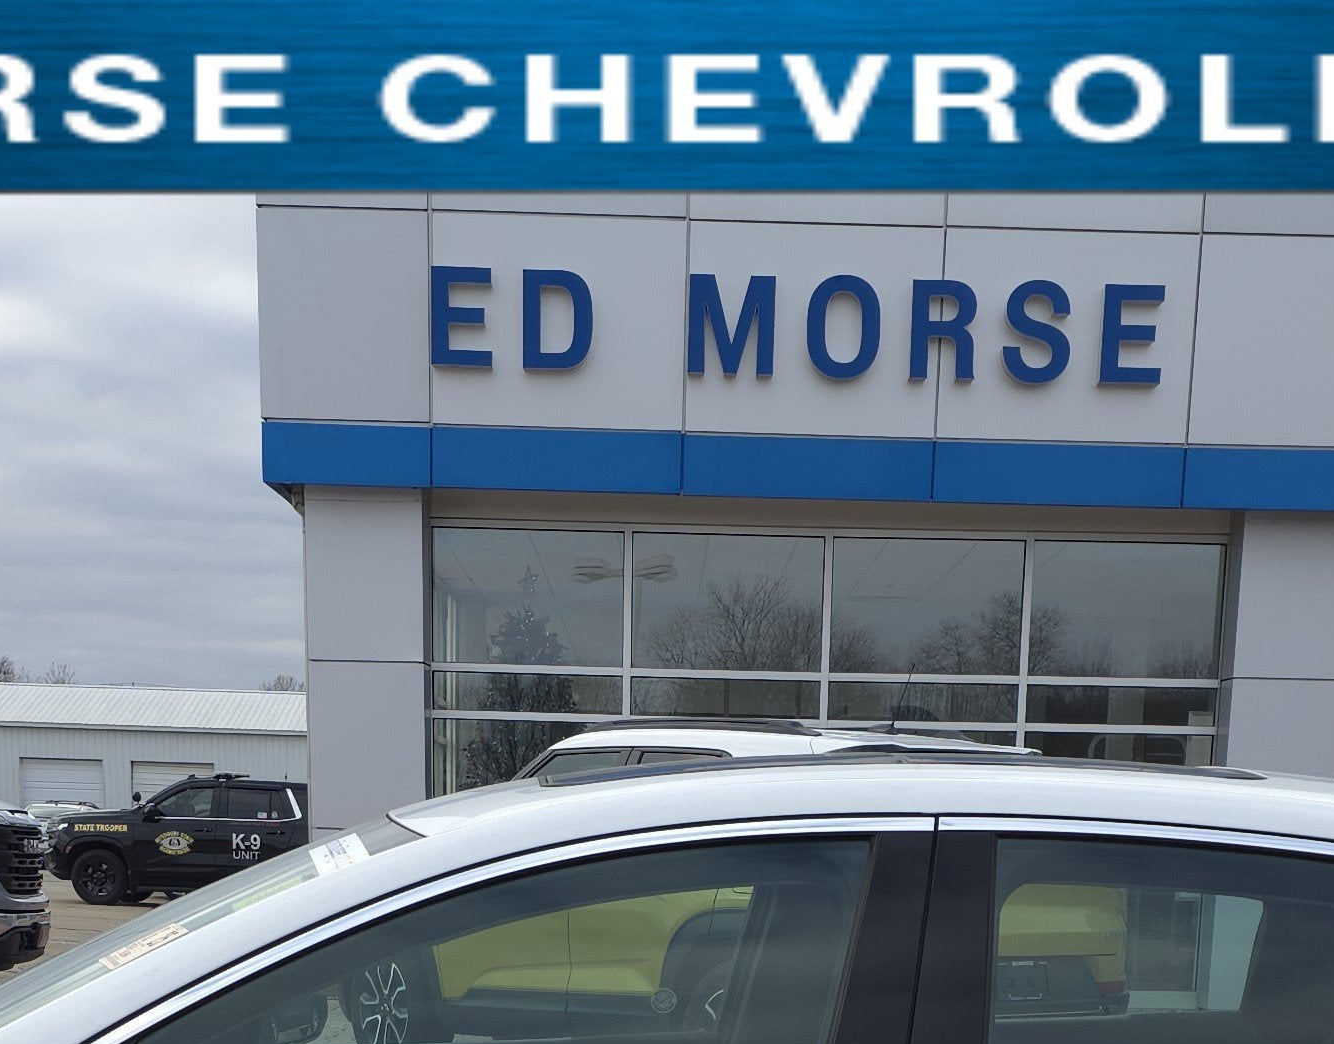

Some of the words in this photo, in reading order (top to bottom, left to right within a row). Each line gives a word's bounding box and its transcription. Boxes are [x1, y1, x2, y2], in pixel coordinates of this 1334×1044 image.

[430, 265, 593, 370] ED
[687, 273, 1166, 386] MORSE
[74, 823, 95, 832] STATE
[96, 823, 128, 833] TROOPER
[232, 832, 261, 850] K-9
[232, 850, 261, 860] UNIT
